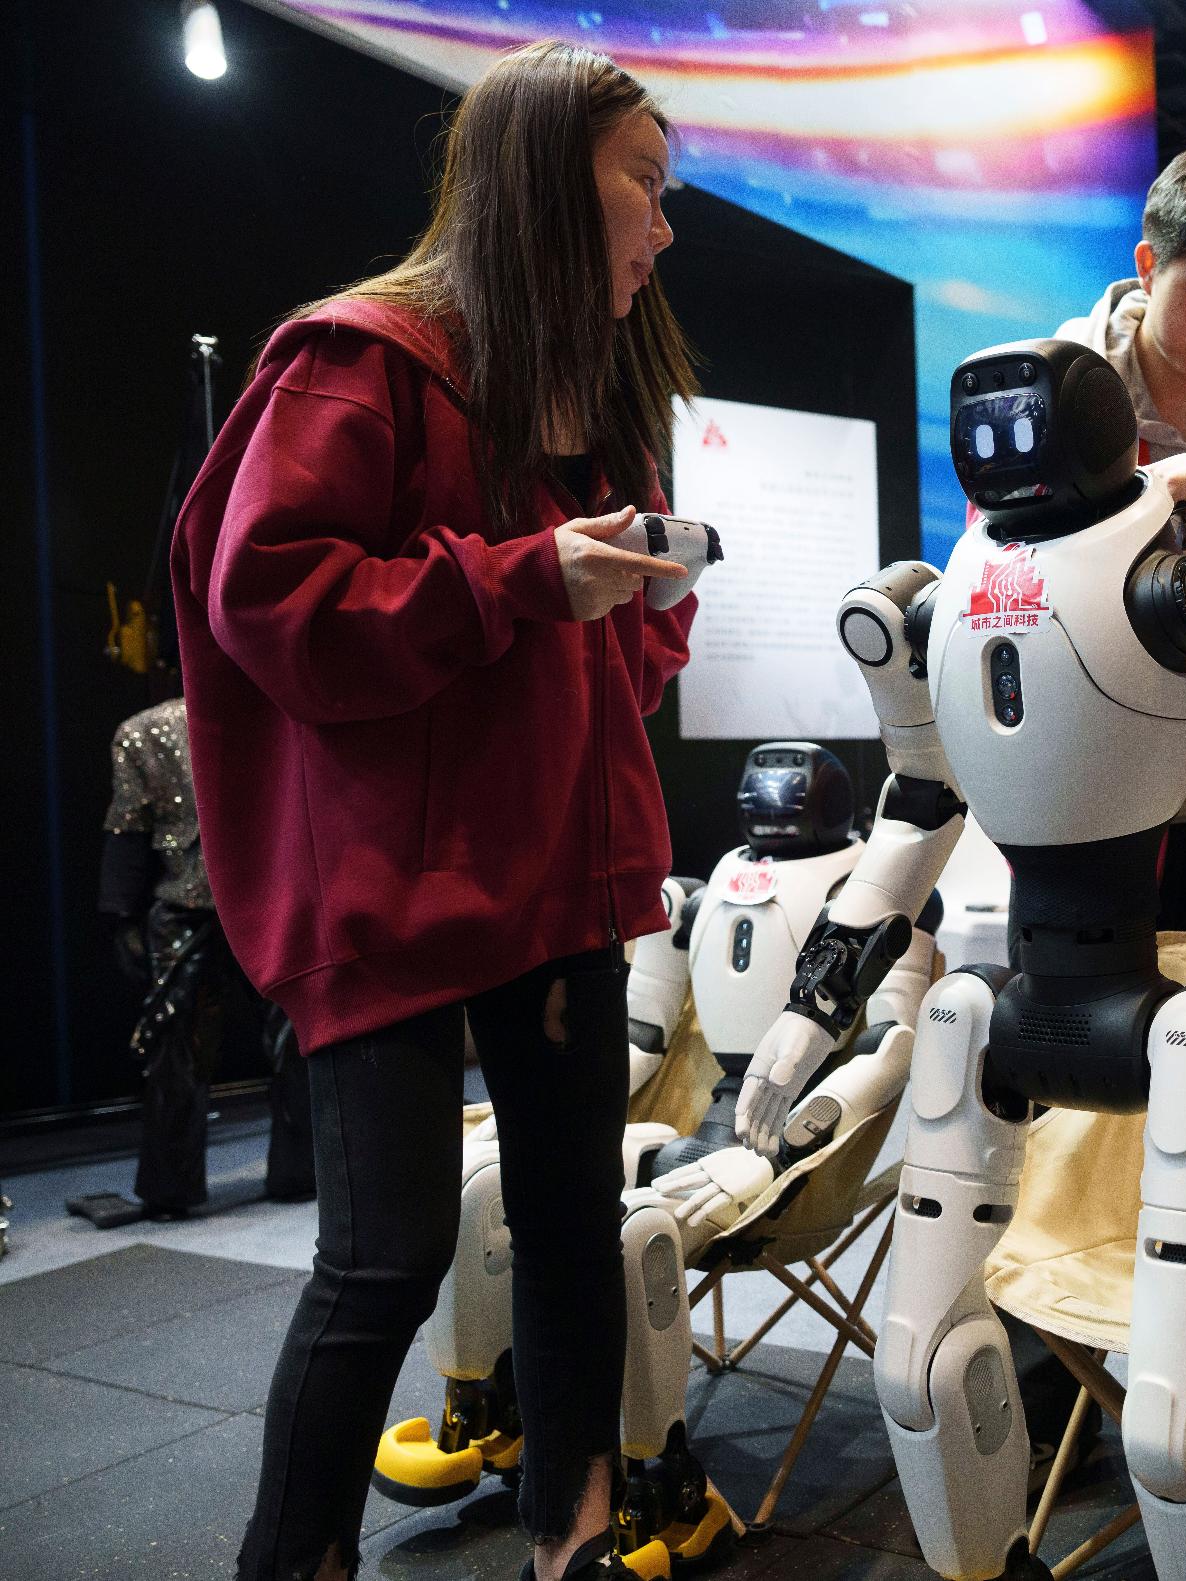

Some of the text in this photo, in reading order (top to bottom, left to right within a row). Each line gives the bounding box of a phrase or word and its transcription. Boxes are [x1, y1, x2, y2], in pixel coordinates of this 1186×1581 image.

[971, 614, 1039, 631] 城市之间科技
